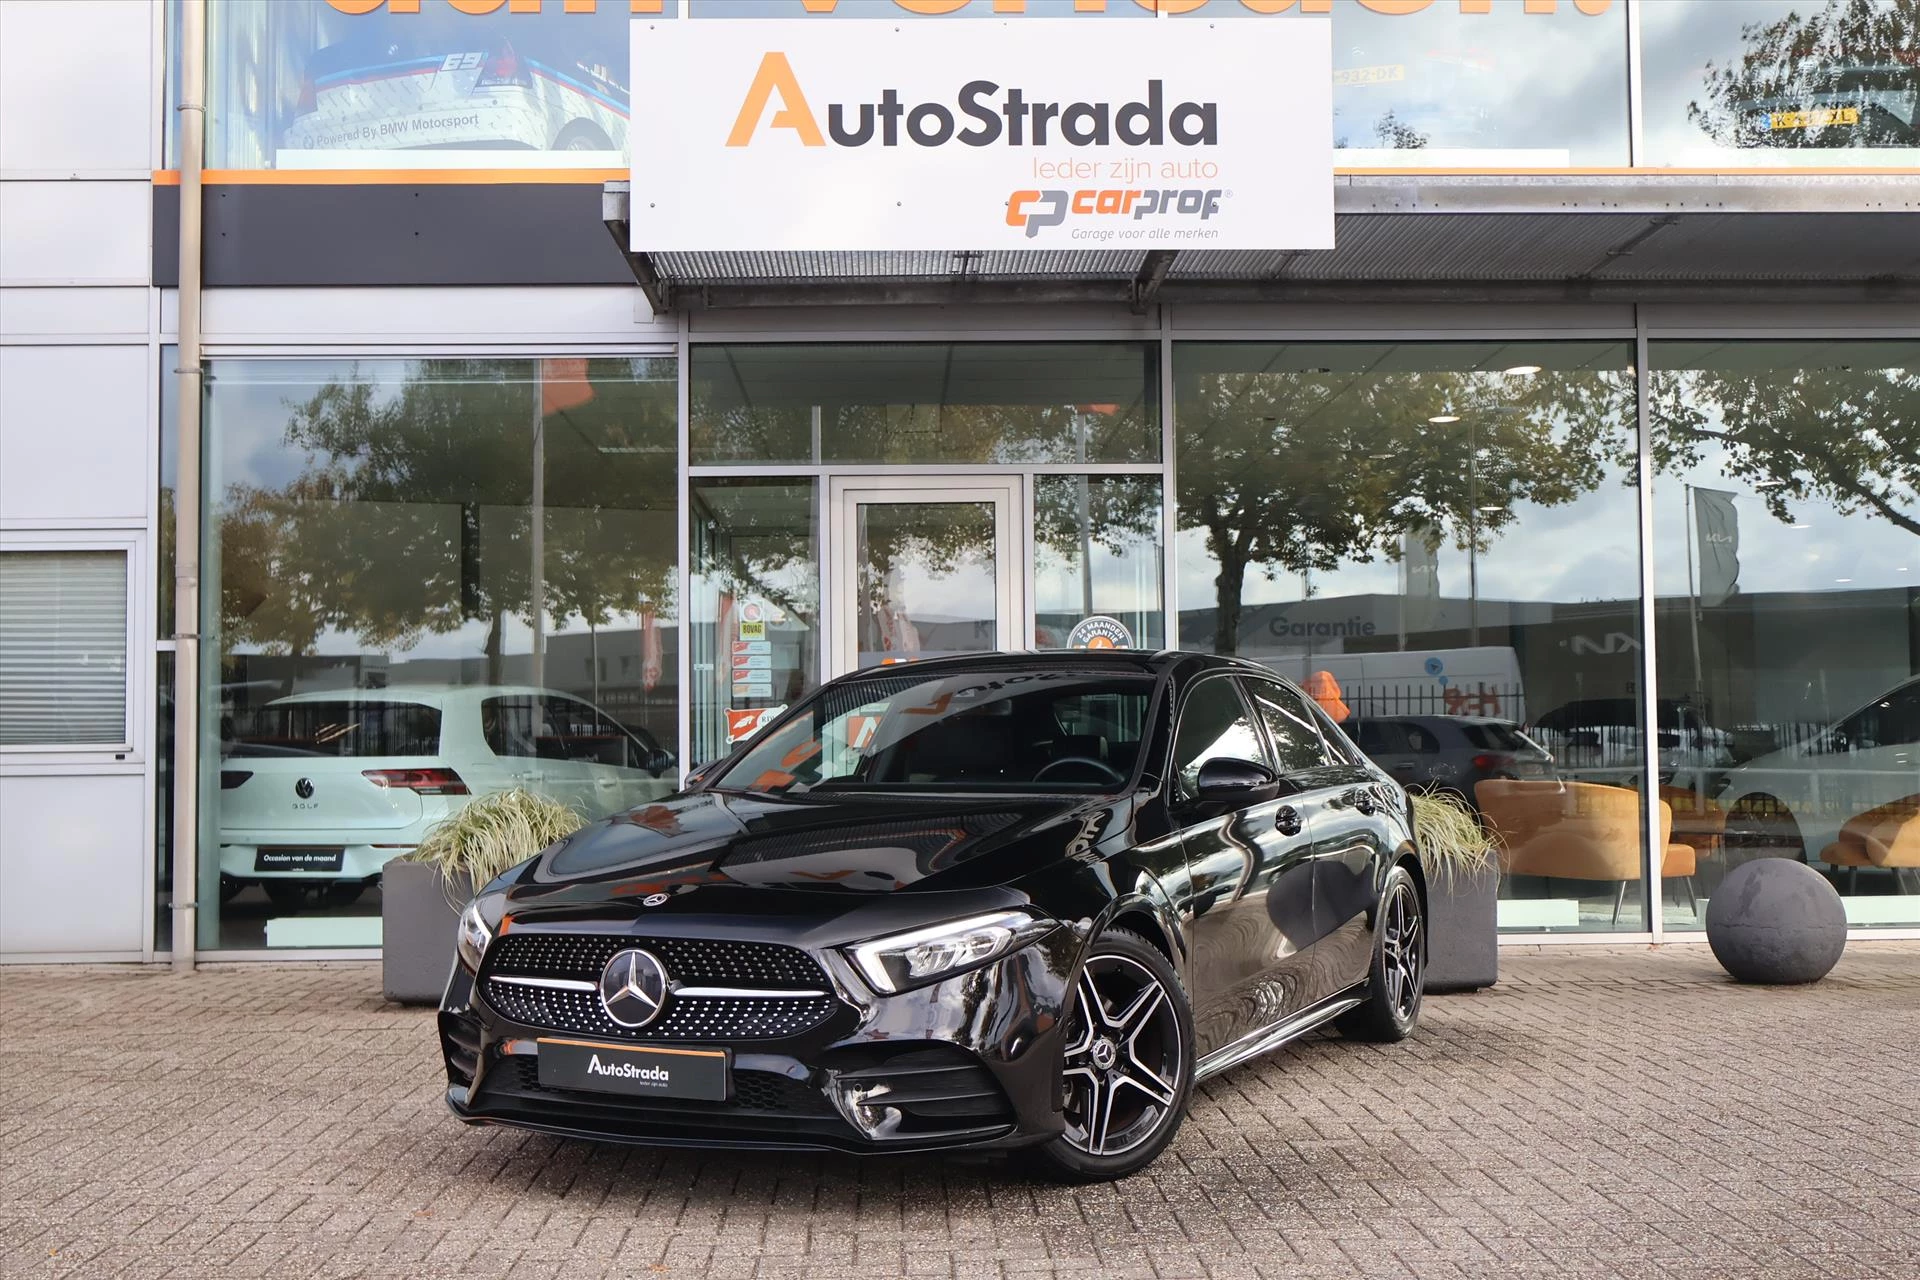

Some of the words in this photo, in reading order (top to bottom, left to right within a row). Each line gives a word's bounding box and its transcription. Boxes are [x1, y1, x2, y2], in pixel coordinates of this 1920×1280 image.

[441, 51, 484, 71] 69
[725, 51, 1218, 147] AutoStrada
[317, 128, 360, 146] Powered
[362, 127, 377, 140] By
[380, 120, 409, 136] BMW
[412, 114, 479, 131] Motorsport
[1033, 157, 1101, 179] Ieder
[1110, 157, 1151, 184] zijn
[1161, 158, 1218, 179] auto
[1071, 189, 1222, 220] carprof
[1071, 228, 1114, 242] Garage
[1118, 230, 1146, 239] voor
[1150, 228, 1170, 239] alle
[1174, 228, 1219, 239] merken
[742, 623, 762, 634] BOVAG
[1077, 628, 1087, 639] 24
[1086, 621, 1125, 639] MAANDEN
[1082, 629, 1119, 644] GARANTIE
[1269, 615, 1377, 637] Garantie
[263, 853, 291, 862] Occasion
[304, 853, 313, 862] de
[313, 853, 337, 862] maand
[587, 1053, 669, 1081] AutoStrada
